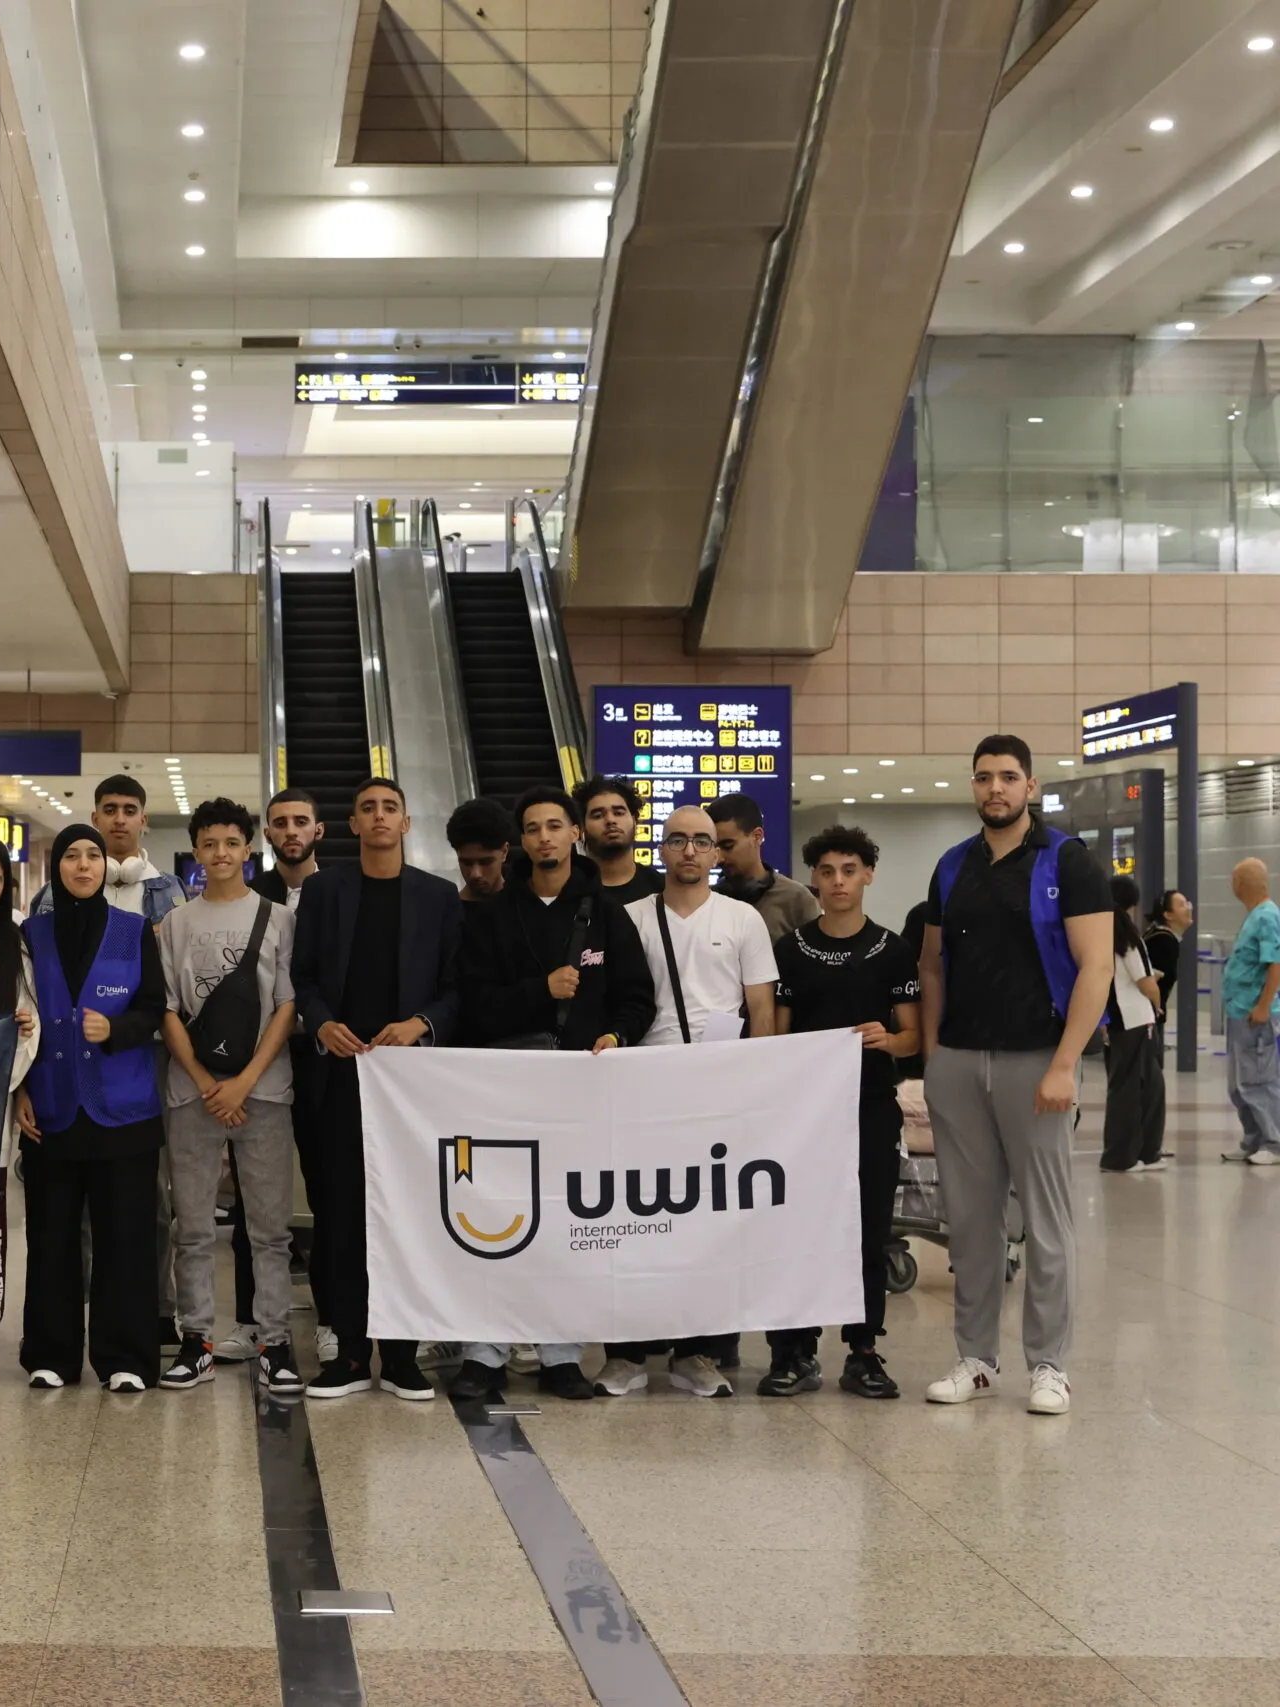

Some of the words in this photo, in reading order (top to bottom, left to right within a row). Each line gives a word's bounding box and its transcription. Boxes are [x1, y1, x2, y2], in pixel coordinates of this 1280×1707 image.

[566, 1142, 786, 1220] uwin
[569, 1219, 673, 1238] international
[569, 1236, 622, 1252] center
